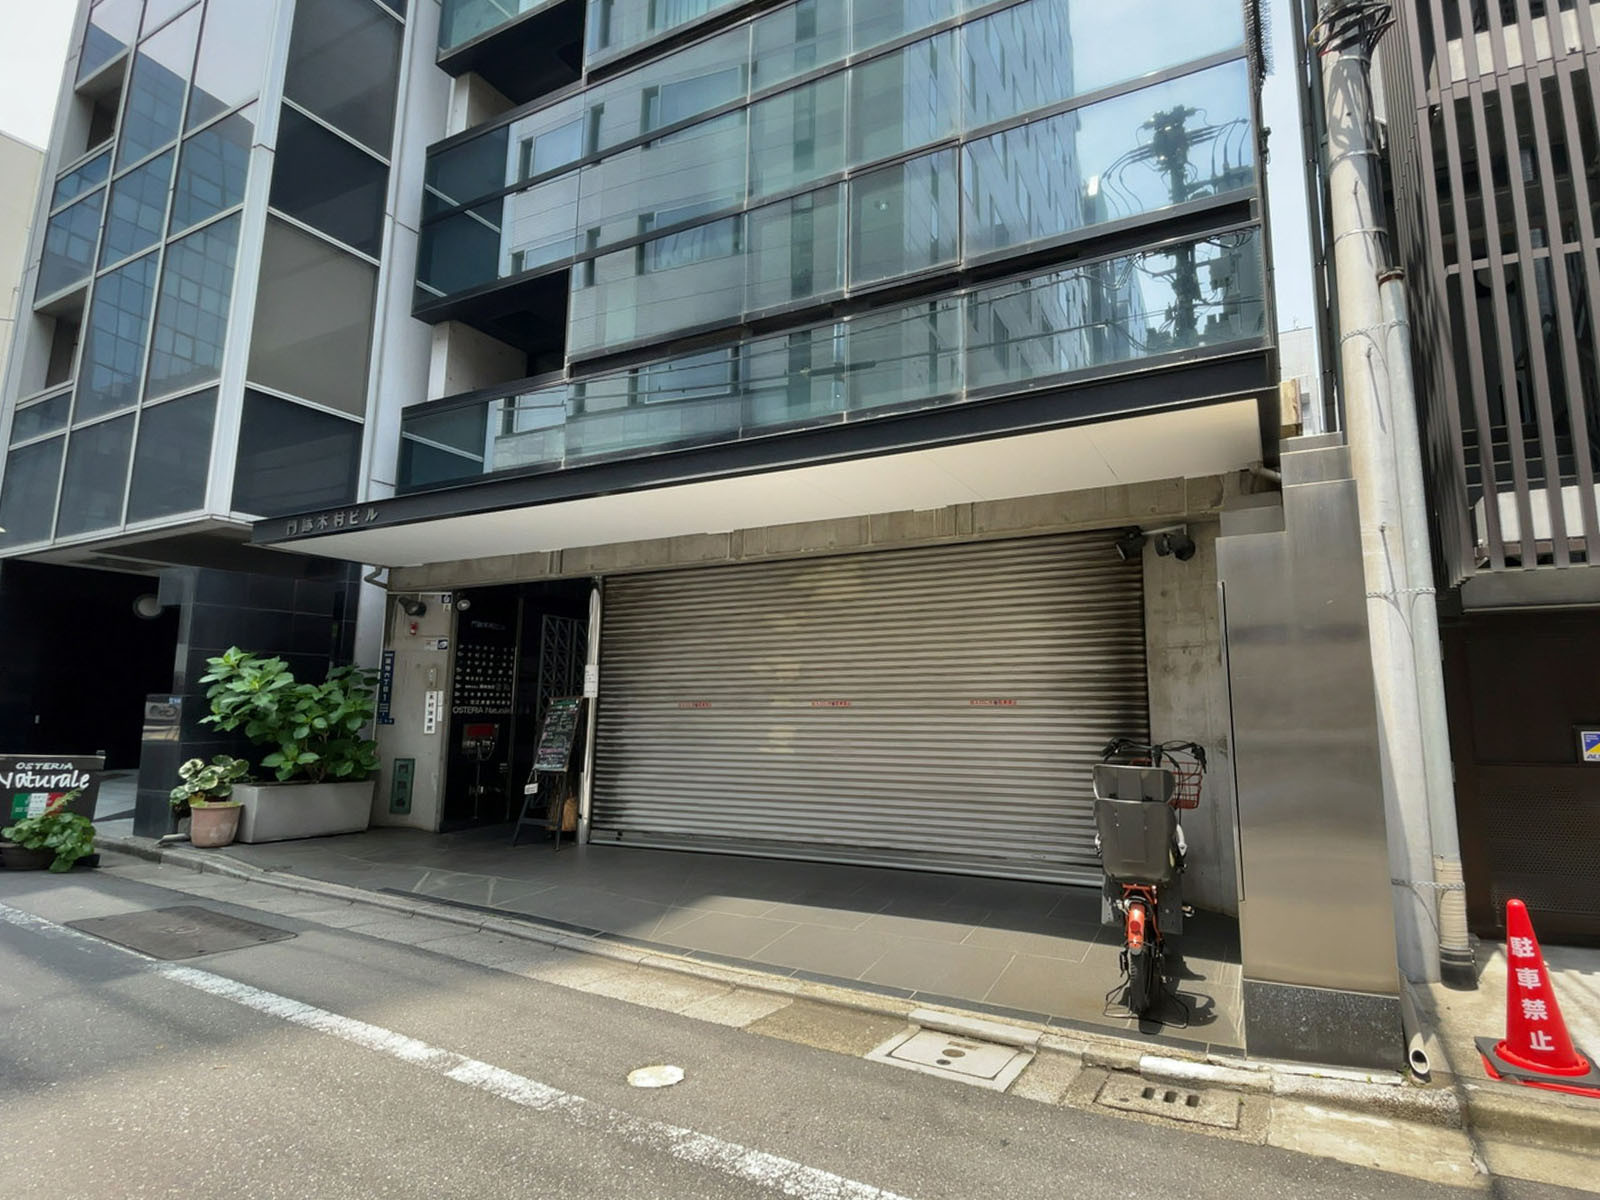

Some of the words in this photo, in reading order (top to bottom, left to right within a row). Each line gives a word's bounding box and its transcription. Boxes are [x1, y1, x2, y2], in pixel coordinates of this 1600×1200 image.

[16, 762, 73, 770] OSTERIA
[0, 770, 90, 789] Naturale
[1510, 936, 1555, 1051] 駐車禁止
